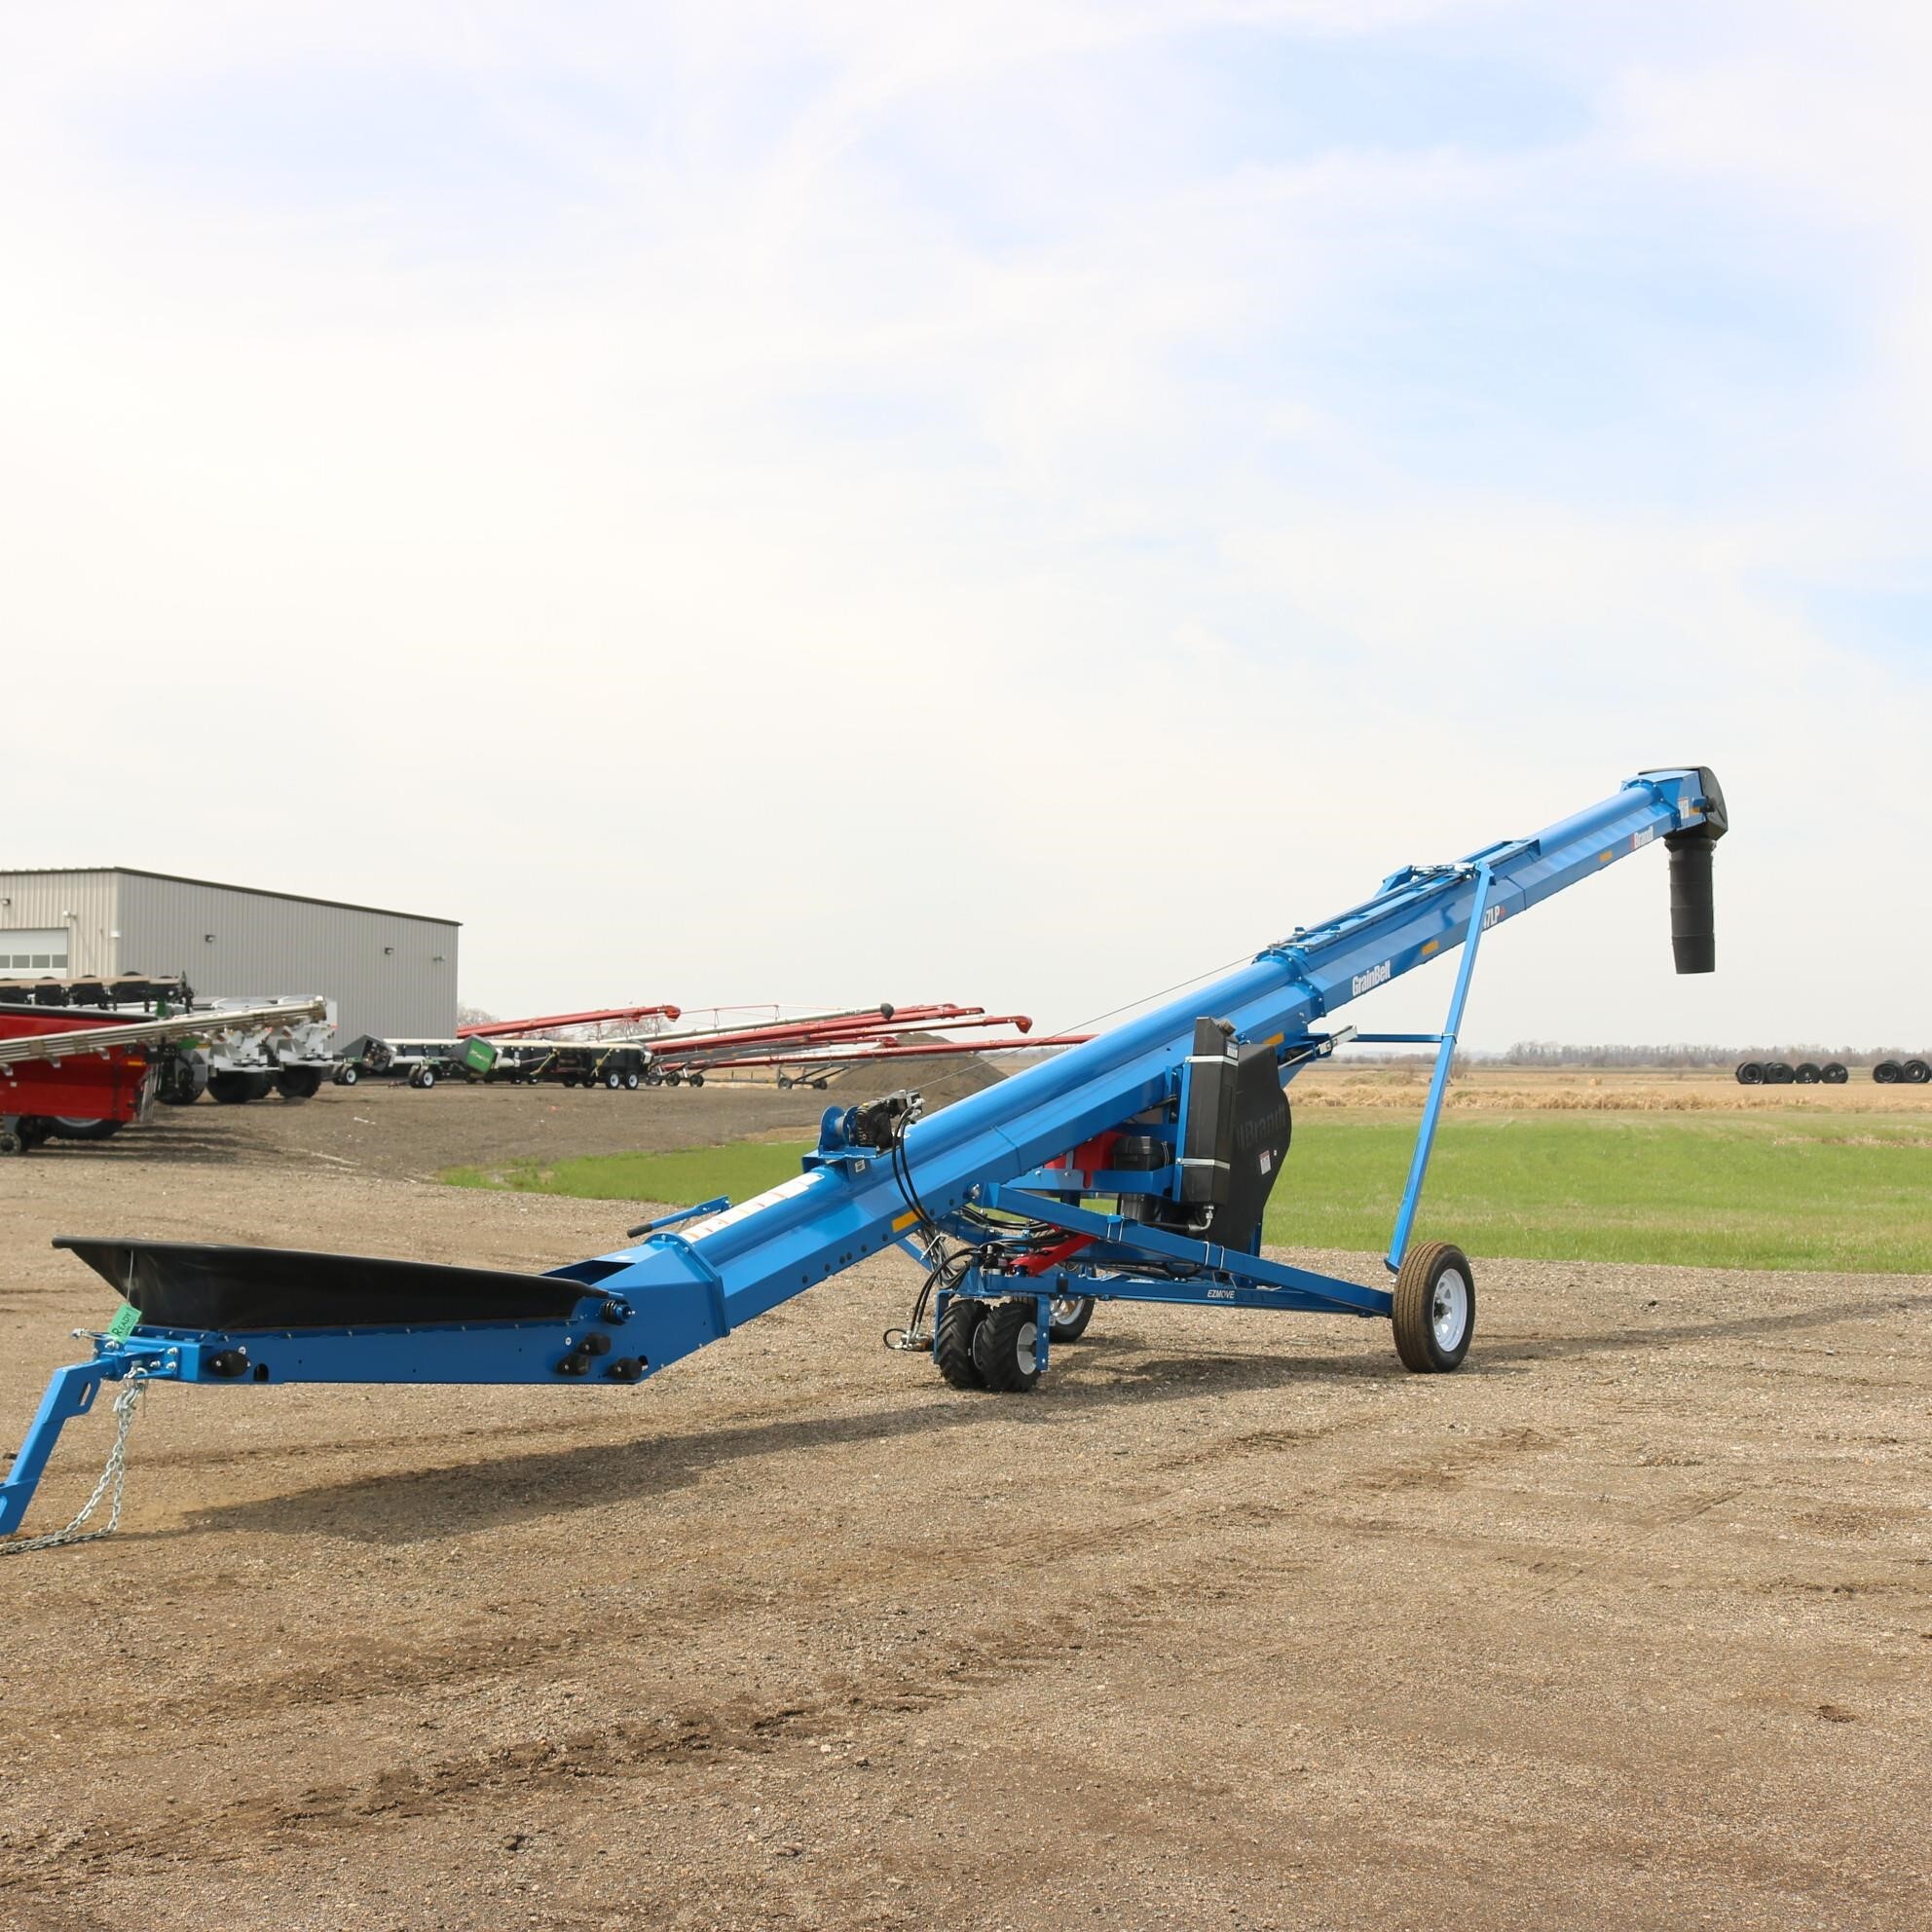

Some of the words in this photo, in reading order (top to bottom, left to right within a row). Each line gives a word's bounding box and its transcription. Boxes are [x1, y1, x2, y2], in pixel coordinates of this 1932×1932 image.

[1352, 960, 1391, 996] GrainBelt
[1207, 1289, 1236, 1299] EZMOVE
[111, 1312, 131, 1336] READY
